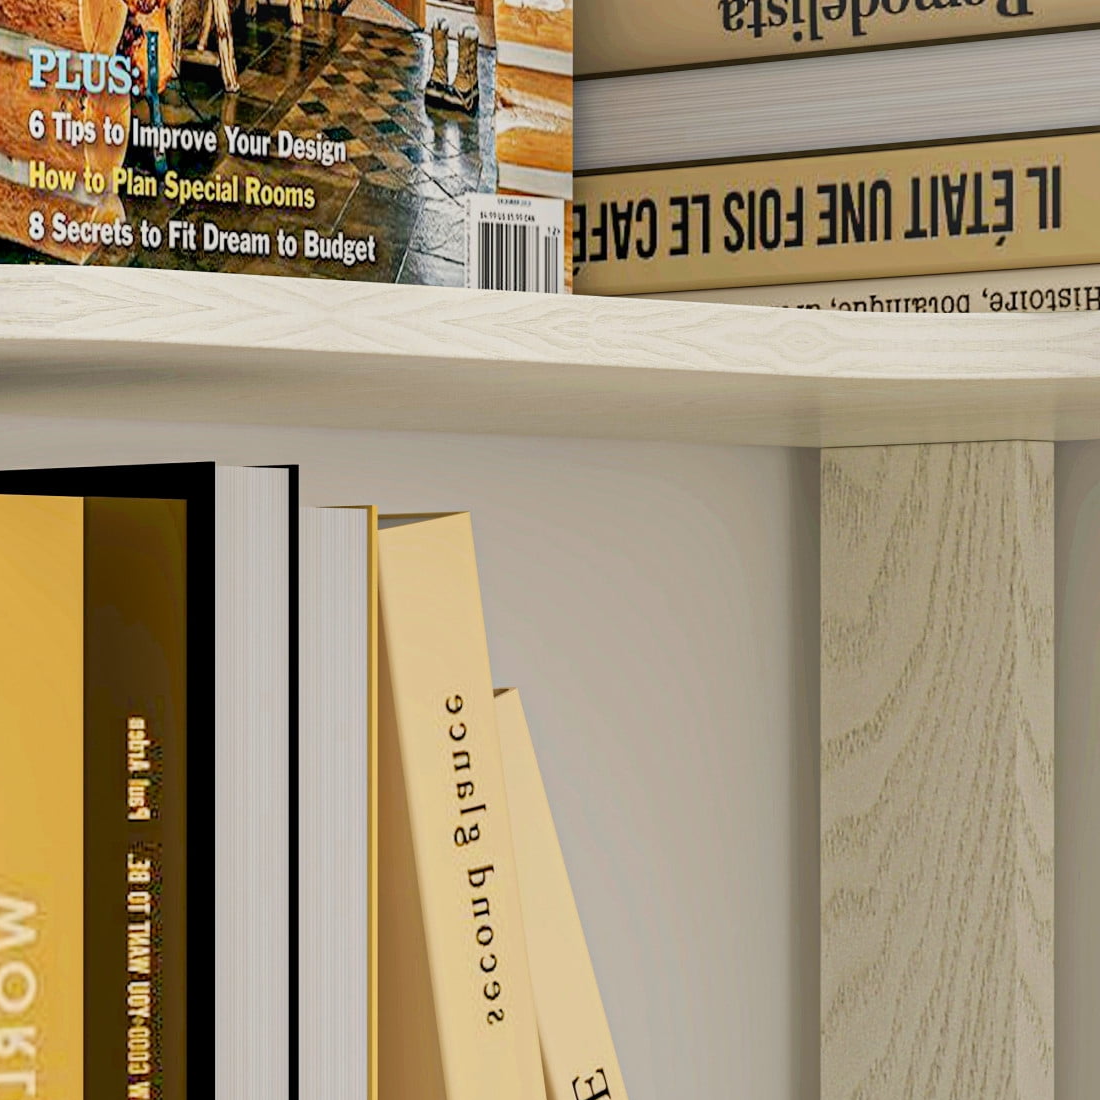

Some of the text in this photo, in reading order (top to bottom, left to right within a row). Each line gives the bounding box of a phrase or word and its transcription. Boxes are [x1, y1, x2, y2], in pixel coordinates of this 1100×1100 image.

[719, 0, 1033, 41] delista
[29, 48, 140, 96] PLUS:
[29, 109, 346, 166] 6 Tips to Improve Your Design
[29, 160, 315, 209] How to Plan Special Rooms
[817, 179, 892, 246] UNE
[904, 170, 1014, 246] ÉTAIT
[1027, 166, 1061, 229] IL
[29, 211, 376, 266] 8 Secrets to Fit Dream to Budget
[669, 195, 710, 256] LE
[724, 187, 803, 253] FOIS
[982, 286, 1100, 313] Histoire,
